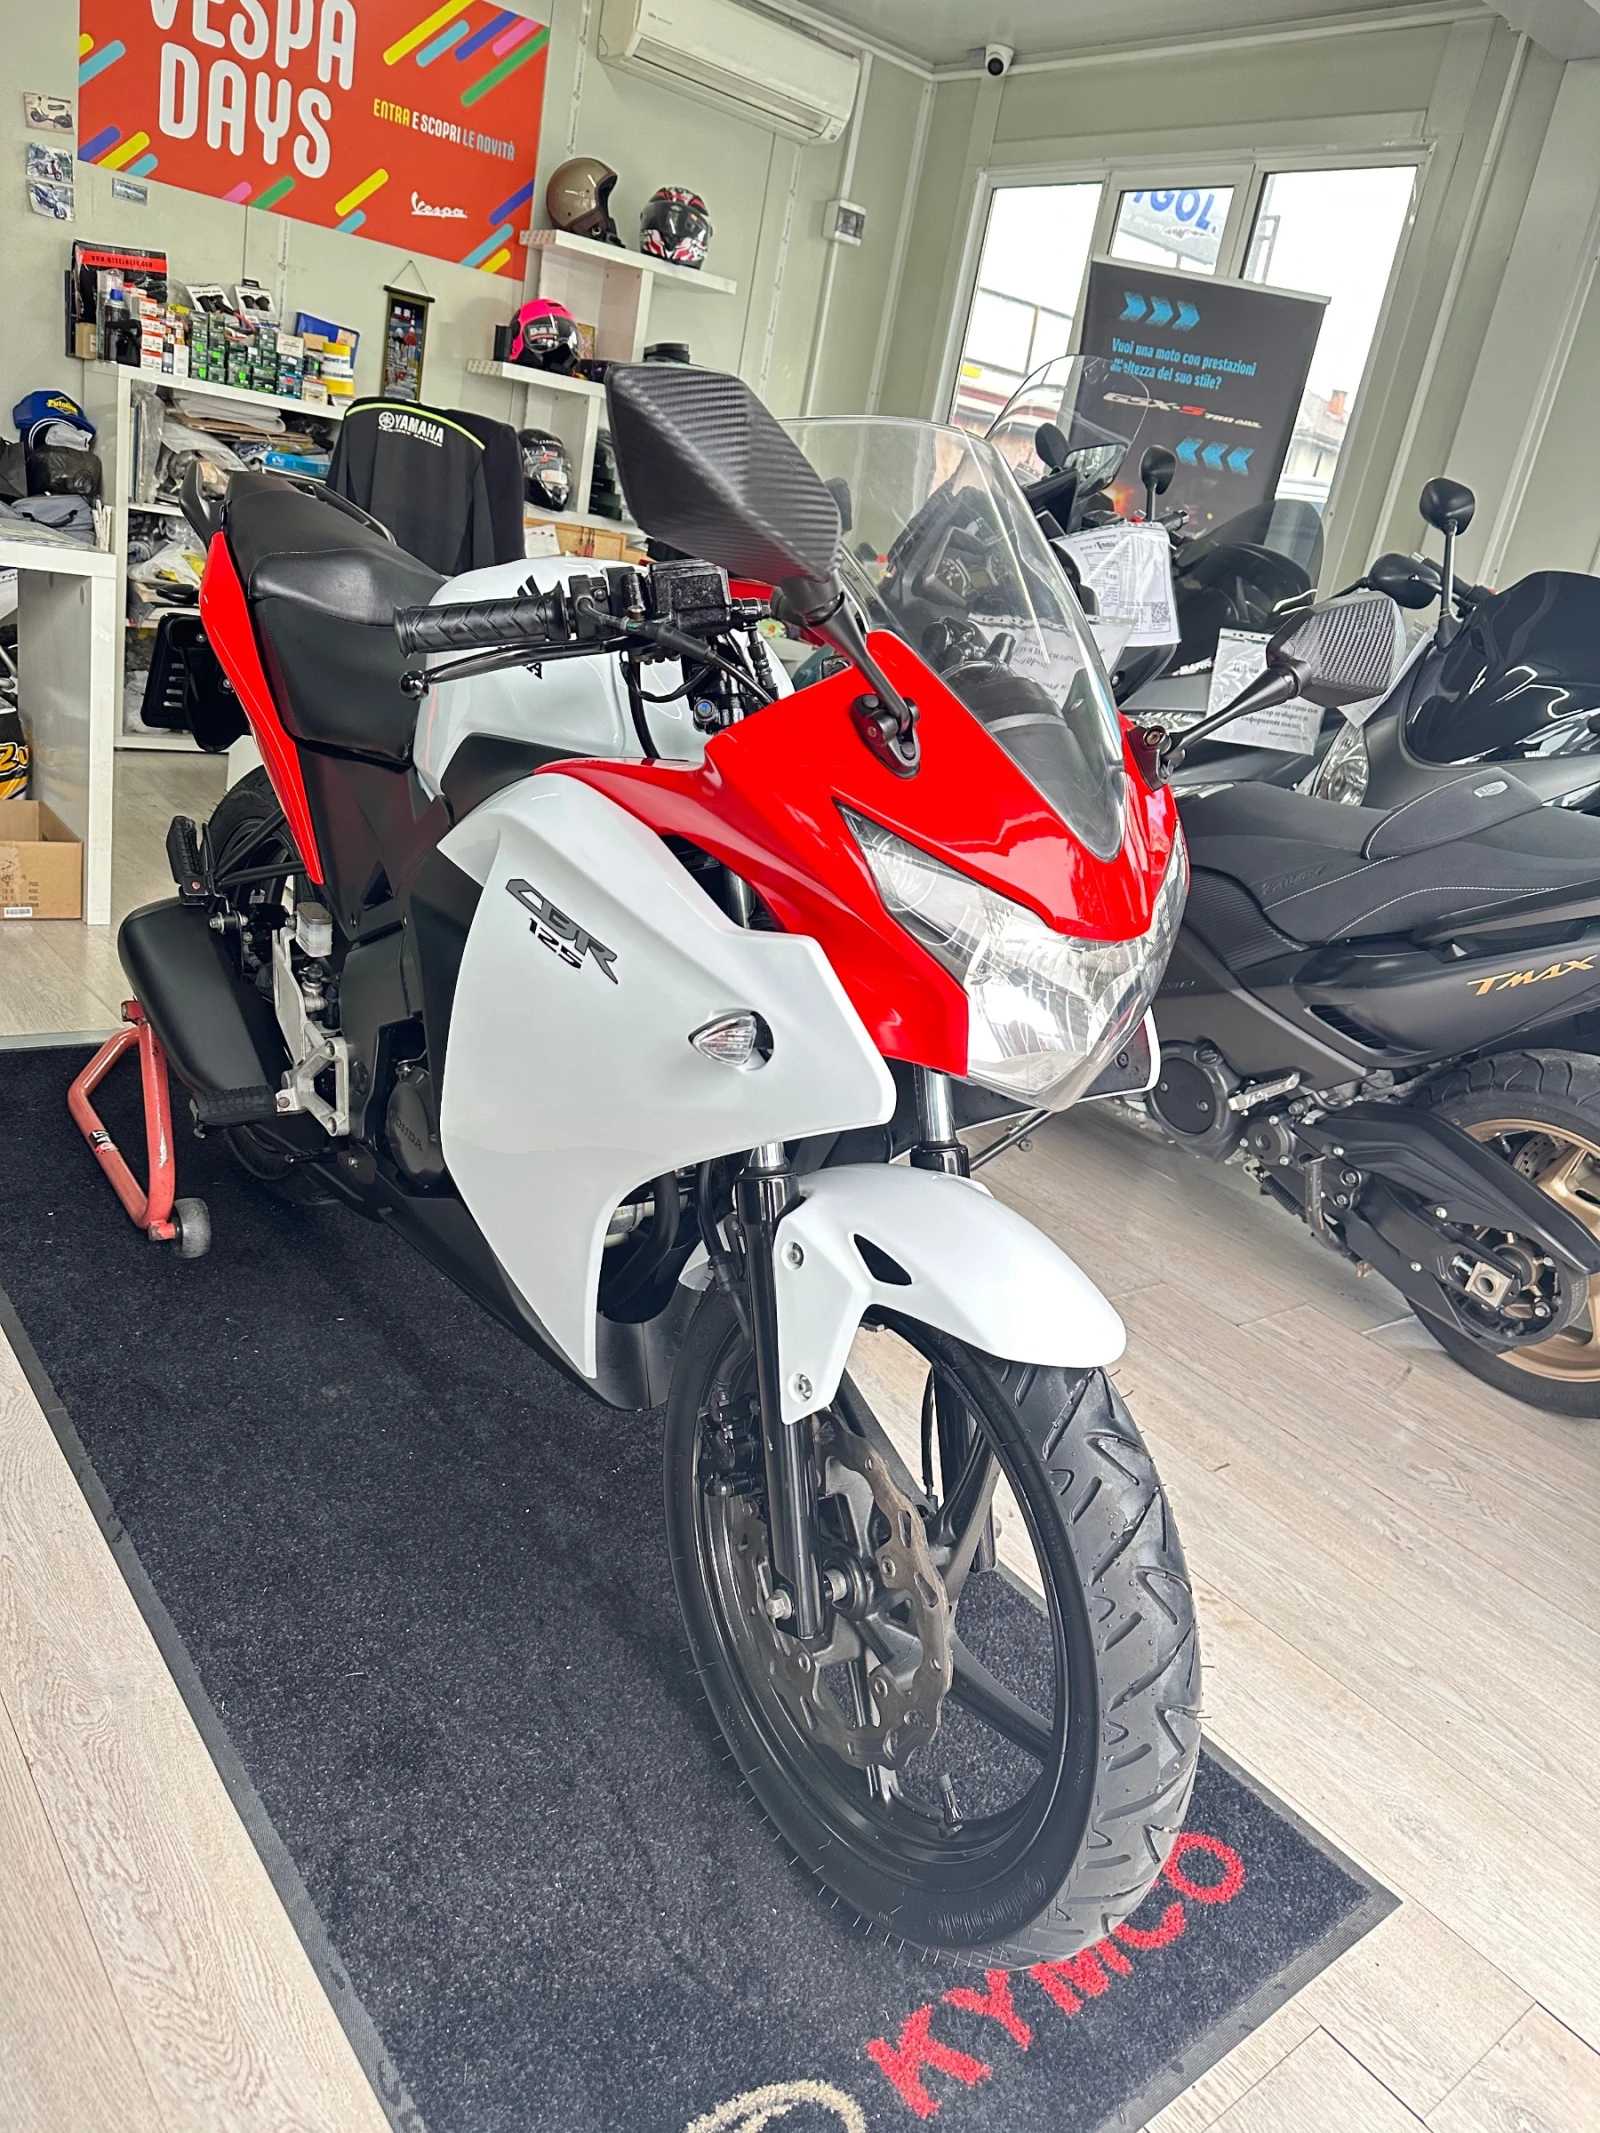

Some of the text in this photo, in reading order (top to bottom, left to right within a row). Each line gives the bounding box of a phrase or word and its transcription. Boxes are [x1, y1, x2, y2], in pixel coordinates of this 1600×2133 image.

[159, 42, 332, 178] DAYS
[373, 98, 515, 161] ENTRA E SCOPRI LE NOVITÀ
[411, 191, 468, 218] Vespa
[1112, 338, 1257, 376] Vuoi una moto con prestazioni
[1157, 366, 1173, 381] del
[1174, 371, 1192, 385] suo
[1193, 373, 1223, 390] stile?
[395, 414, 444, 444] YAMAHA
[505, 878, 619, 985] CBR
[529, 917, 583, 970] 125
[1466, 954, 1598, 996] TMAX
